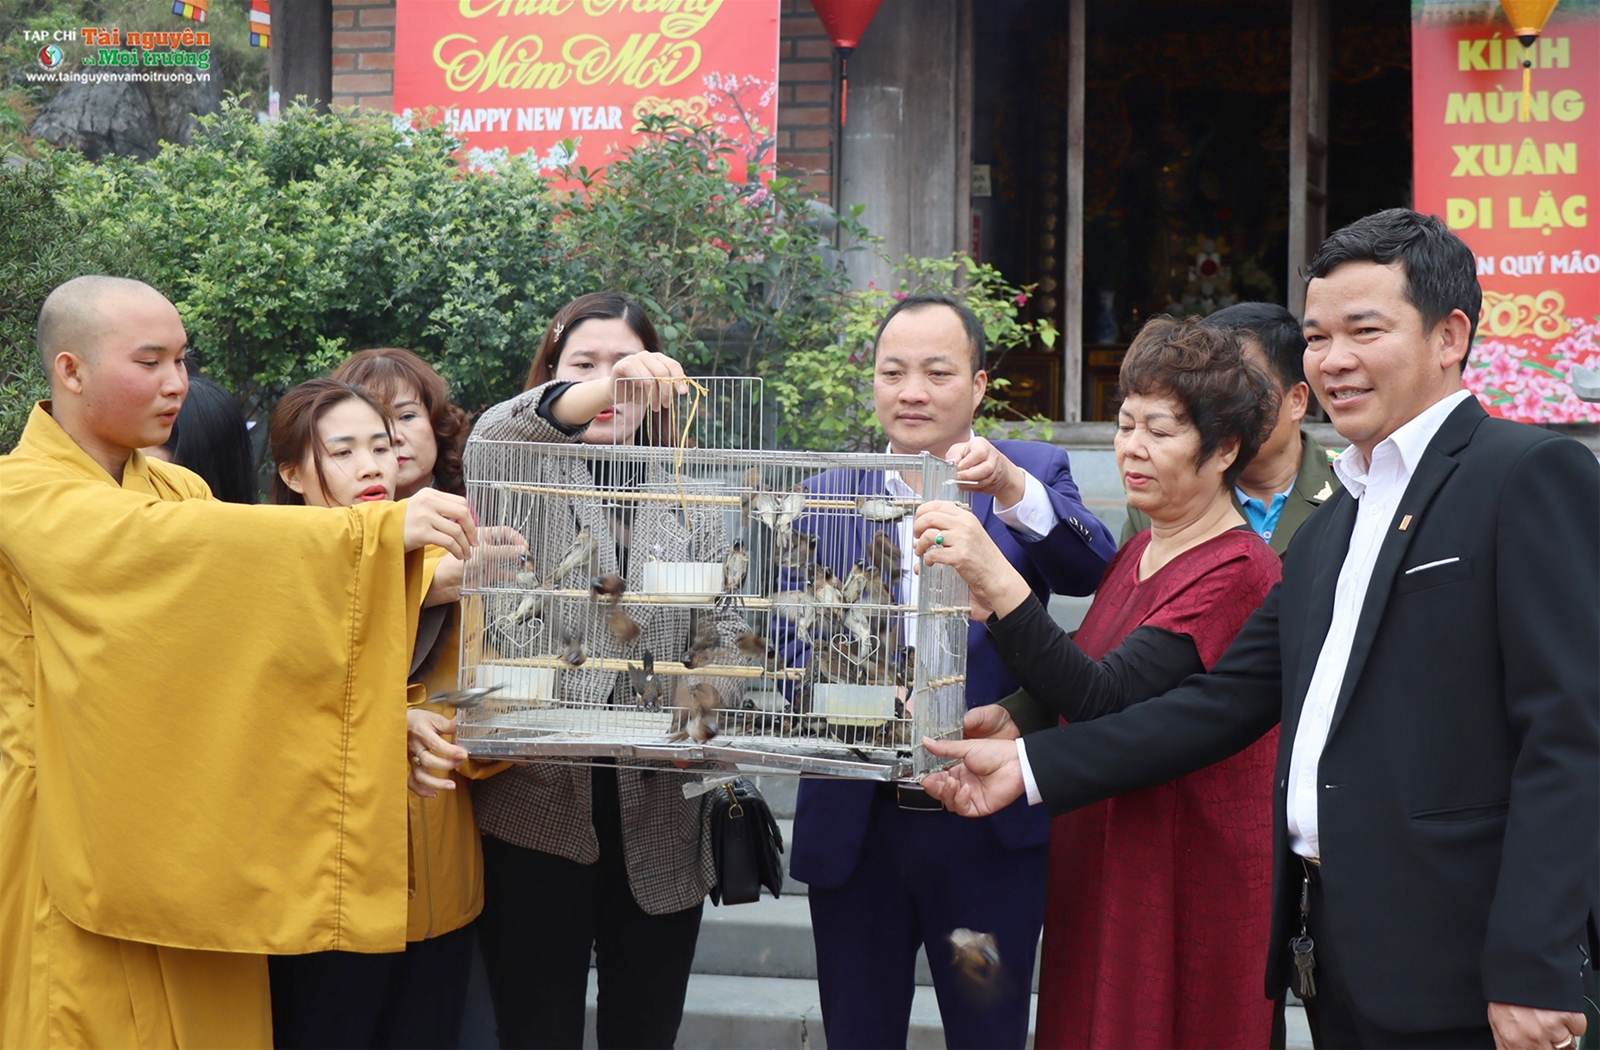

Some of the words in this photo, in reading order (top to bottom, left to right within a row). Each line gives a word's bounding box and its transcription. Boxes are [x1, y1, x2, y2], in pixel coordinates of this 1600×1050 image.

[432, 33, 572, 94] Năm
[561, 32, 703, 90] Mới
[1457, 32, 1570, 71] KÍNH
[444, 107, 512, 133] HAPPY
[516, 107, 565, 132] NEW
[569, 106, 624, 131] YEAR
[1444, 84, 1585, 124] MỪNG
[1450, 137, 1578, 177] XUÂN
[1446, 196, 1493, 230] DI
[1508, 190, 1588, 236] LẶC
[1499, 250, 1546, 278] QUÝ
[1549, 250, 1600, 275] MÃO
